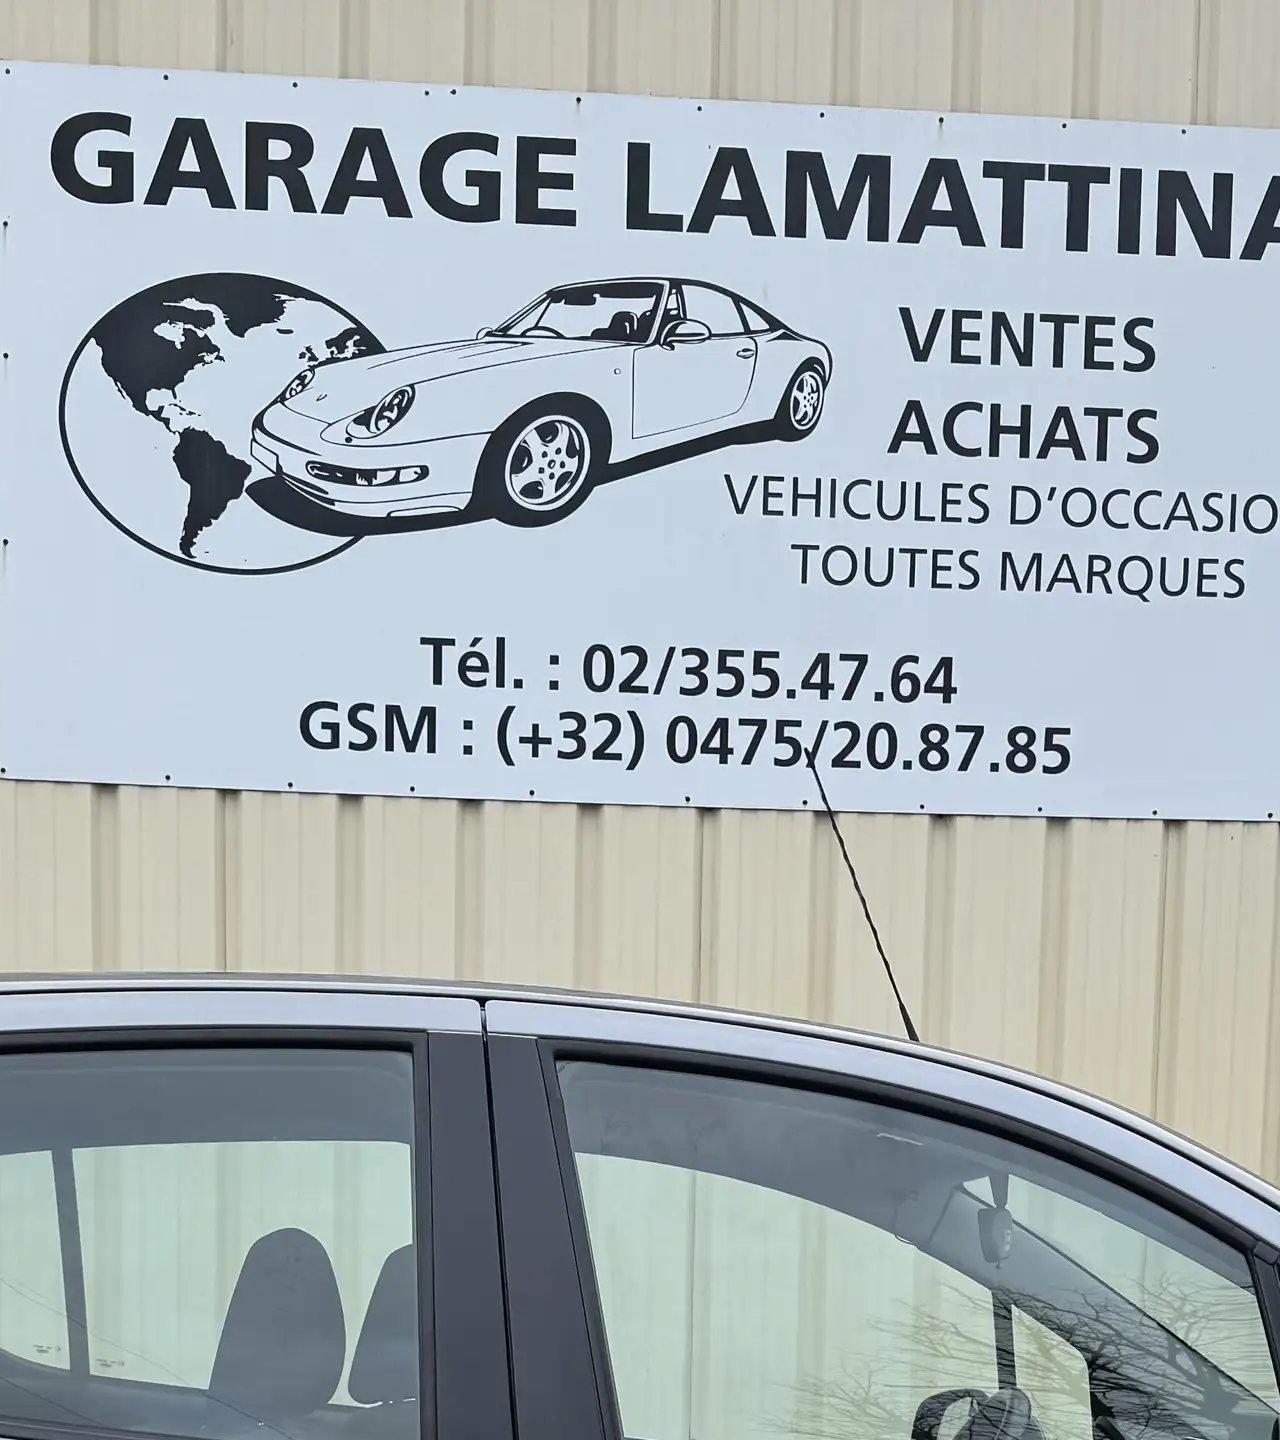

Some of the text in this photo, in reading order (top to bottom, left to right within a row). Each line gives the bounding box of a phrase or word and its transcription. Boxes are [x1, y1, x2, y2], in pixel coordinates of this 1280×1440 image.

[50, 111, 577, 227] GARAGE
[899, 306, 1156, 372] VENTES
[887, 399, 1160, 464] ACHATS
[723, 473, 990, 525] VEHICULES
[790, 543, 1245, 603] TOUTES MARQUES
[419, 636, 524, 690] Tél.
[583, 643, 958, 705] 02/355.47.64
[299, 700, 437, 754] GSM
[497, 705, 645, 771] (+32)
[666, 715, 1071, 781] 0475/20.87.85
